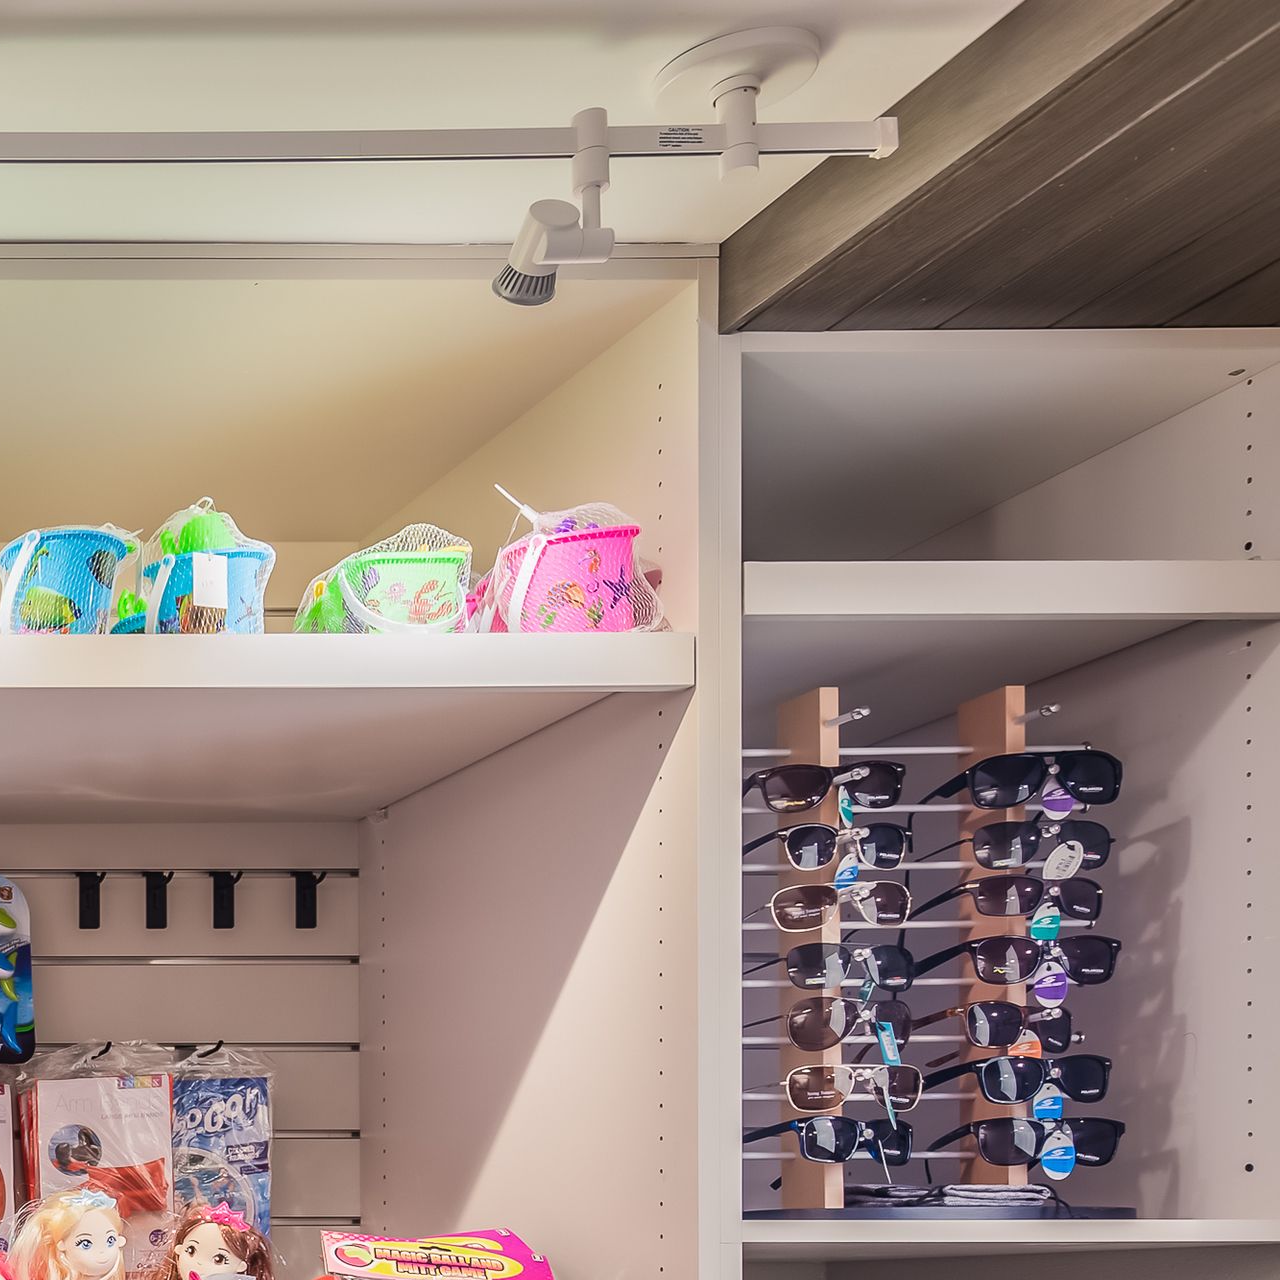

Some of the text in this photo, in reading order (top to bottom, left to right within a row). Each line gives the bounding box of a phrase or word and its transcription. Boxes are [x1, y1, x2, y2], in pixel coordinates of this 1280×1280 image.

[374, 1248, 504, 1271] MAGIC BALL AND
[396, 1261, 488, 1279] MITT GAME
